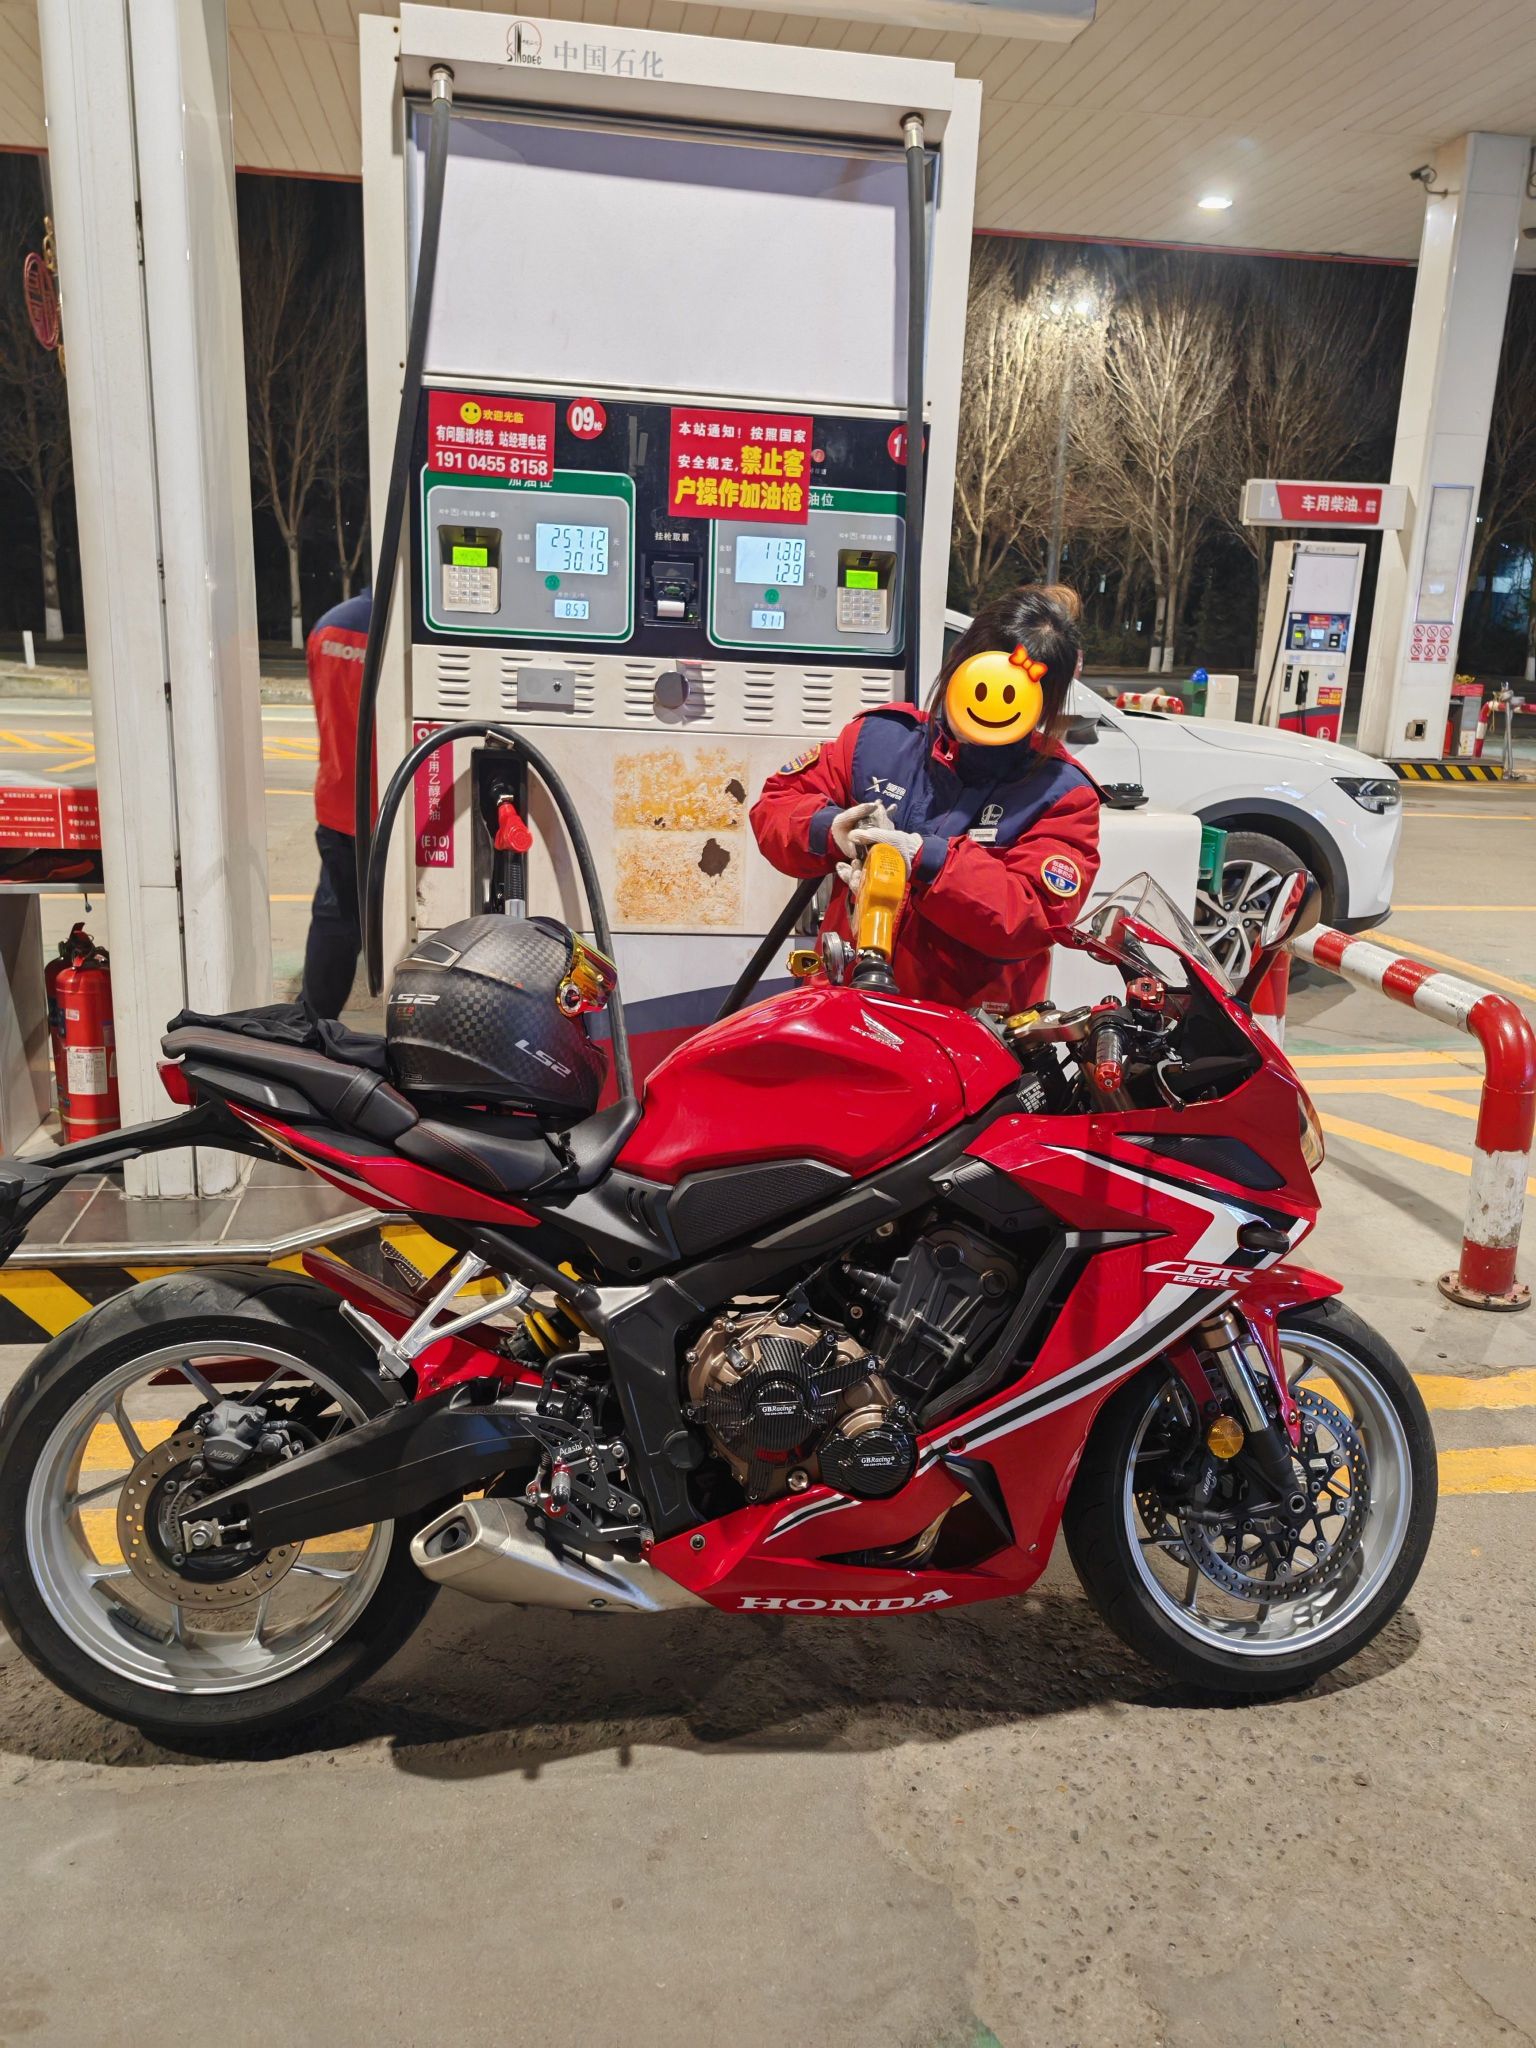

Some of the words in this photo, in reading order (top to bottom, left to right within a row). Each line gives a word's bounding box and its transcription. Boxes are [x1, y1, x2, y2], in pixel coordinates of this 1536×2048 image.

[554, 40, 664, 79] 中国石化
[483, 409, 524, 424] 欢迎光临
[436, 425, 494, 446] 有问题请找我
[499, 431, 547, 451] 站经理电话
[435, 451, 462, 468] 191
[468, 454, 505, 472] 0455
[510, 458, 548, 476] 8158
[675, 475, 803, 512] 户操作加油枪
[1301, 494, 1358, 512] 车用柴油
[551, 527, 606, 550] 257.12
[654, 531, 690, 542] 挂枪取票
[563, 551, 605, 572] 30.15
[776, 563, 802, 583] 1.29
[421, 835, 450, 849] (E10)
[425, 851, 448, 863] (VIB)
[514, 1039, 572, 1079] LS2
[1143, 1260, 1255, 1284] CBR
[1172, 1274, 1231, 1288] 650R
[737, 1588, 954, 1612] HONDA
